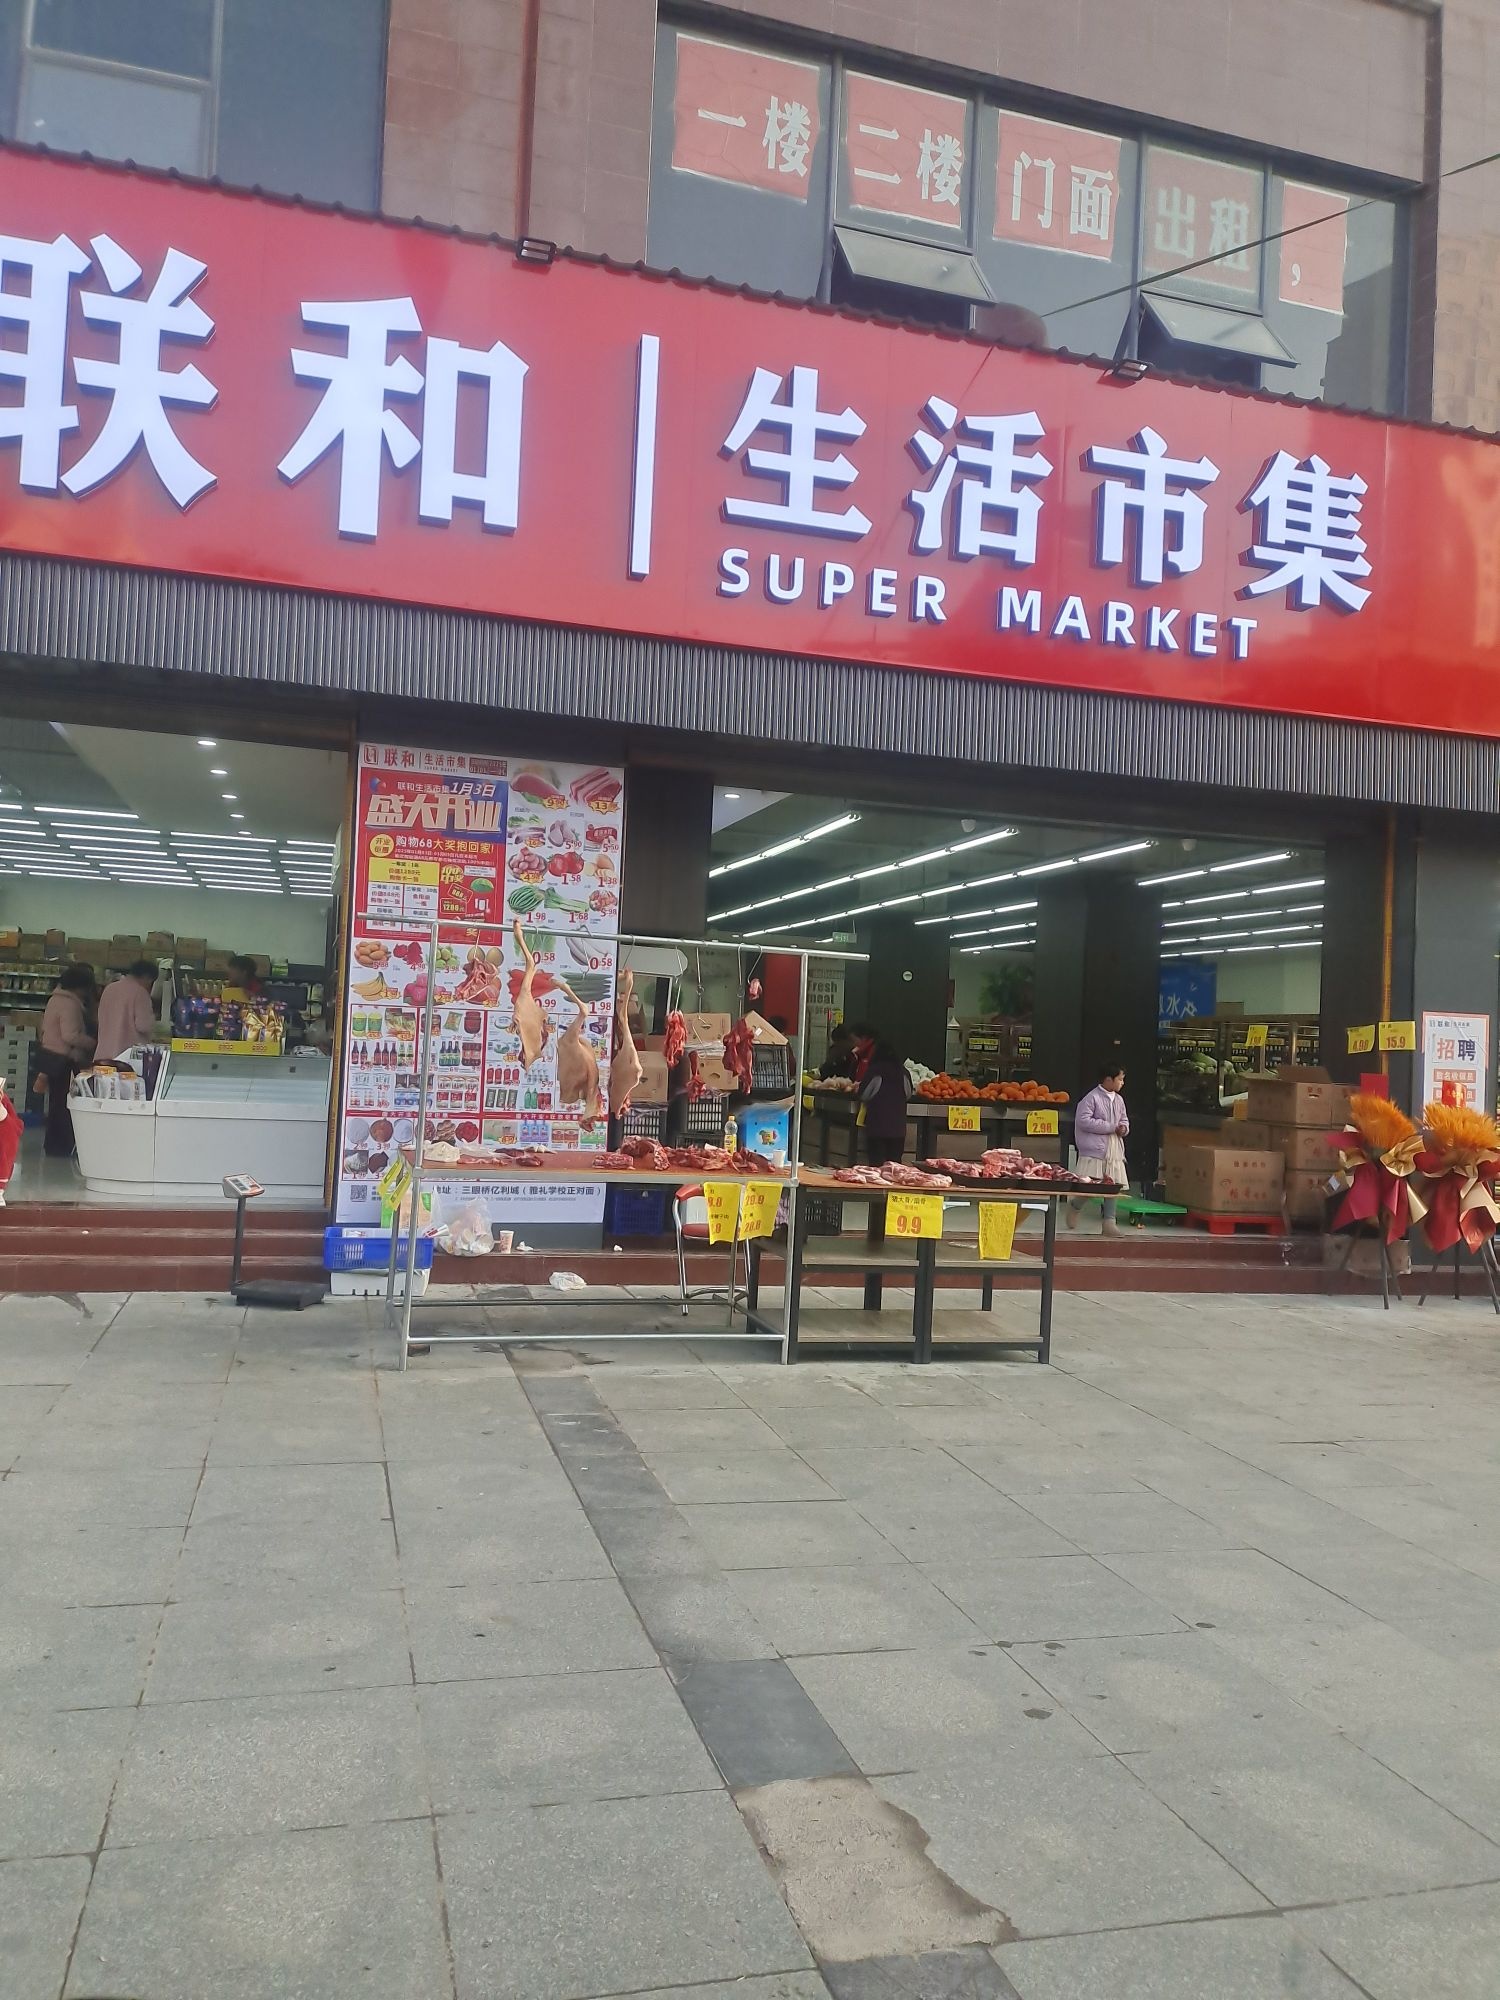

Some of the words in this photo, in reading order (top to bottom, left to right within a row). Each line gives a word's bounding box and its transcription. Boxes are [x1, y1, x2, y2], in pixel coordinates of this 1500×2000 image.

[1154, 186, 1250, 272] 出租
[0, 232, 530, 540] 联和
[717, 365, 1373, 613] 生活市集
[717, 547, 948, 624] SUPER
[996, 586, 1259, 659] MARKET
[384, 746, 415, 768] 联和
[424, 753, 466, 769] 生活市集
[451, 782, 496, 797] 1月3日
[365, 794, 502, 832] 盛大开业
[561, 873, 582, 885] 1.58
[526, 911, 546, 922] 1.98
[569, 911, 589, 923] 1.68
[589, 957, 612, 969] 0.58
[589, 1001, 611, 1014] 1.98
[1386, 1036, 1406, 1048] 15.9
[1436, 1037, 1476, 1061] 招聘
[897, 1215, 922, 1234] 9.9
